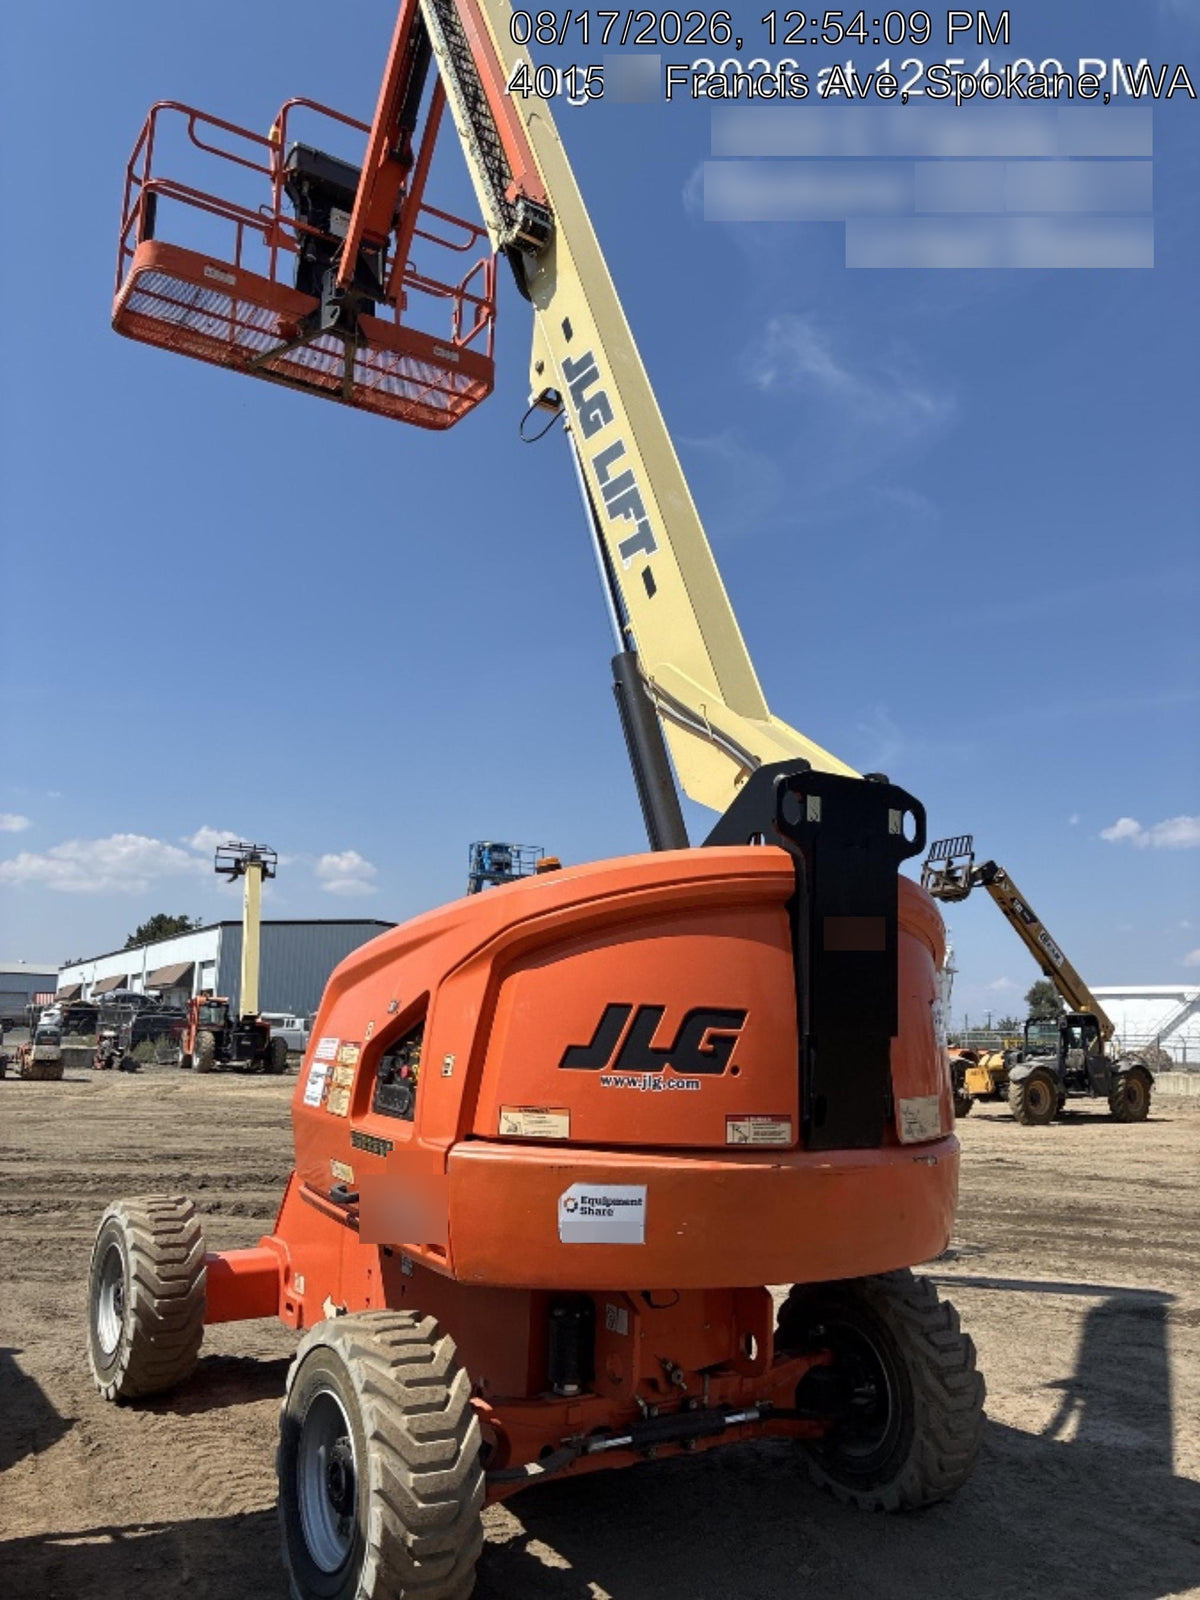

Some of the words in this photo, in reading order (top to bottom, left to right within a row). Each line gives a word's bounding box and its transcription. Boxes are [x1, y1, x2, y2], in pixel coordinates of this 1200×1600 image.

[560, 350, 615, 441] JLG
[591, 437, 659, 562] LIFT
[599, 1074, 701, 1092] www.jlg.com
[580, 1195, 643, 1208] Equipment
[579, 1206, 615, 1217] Share
